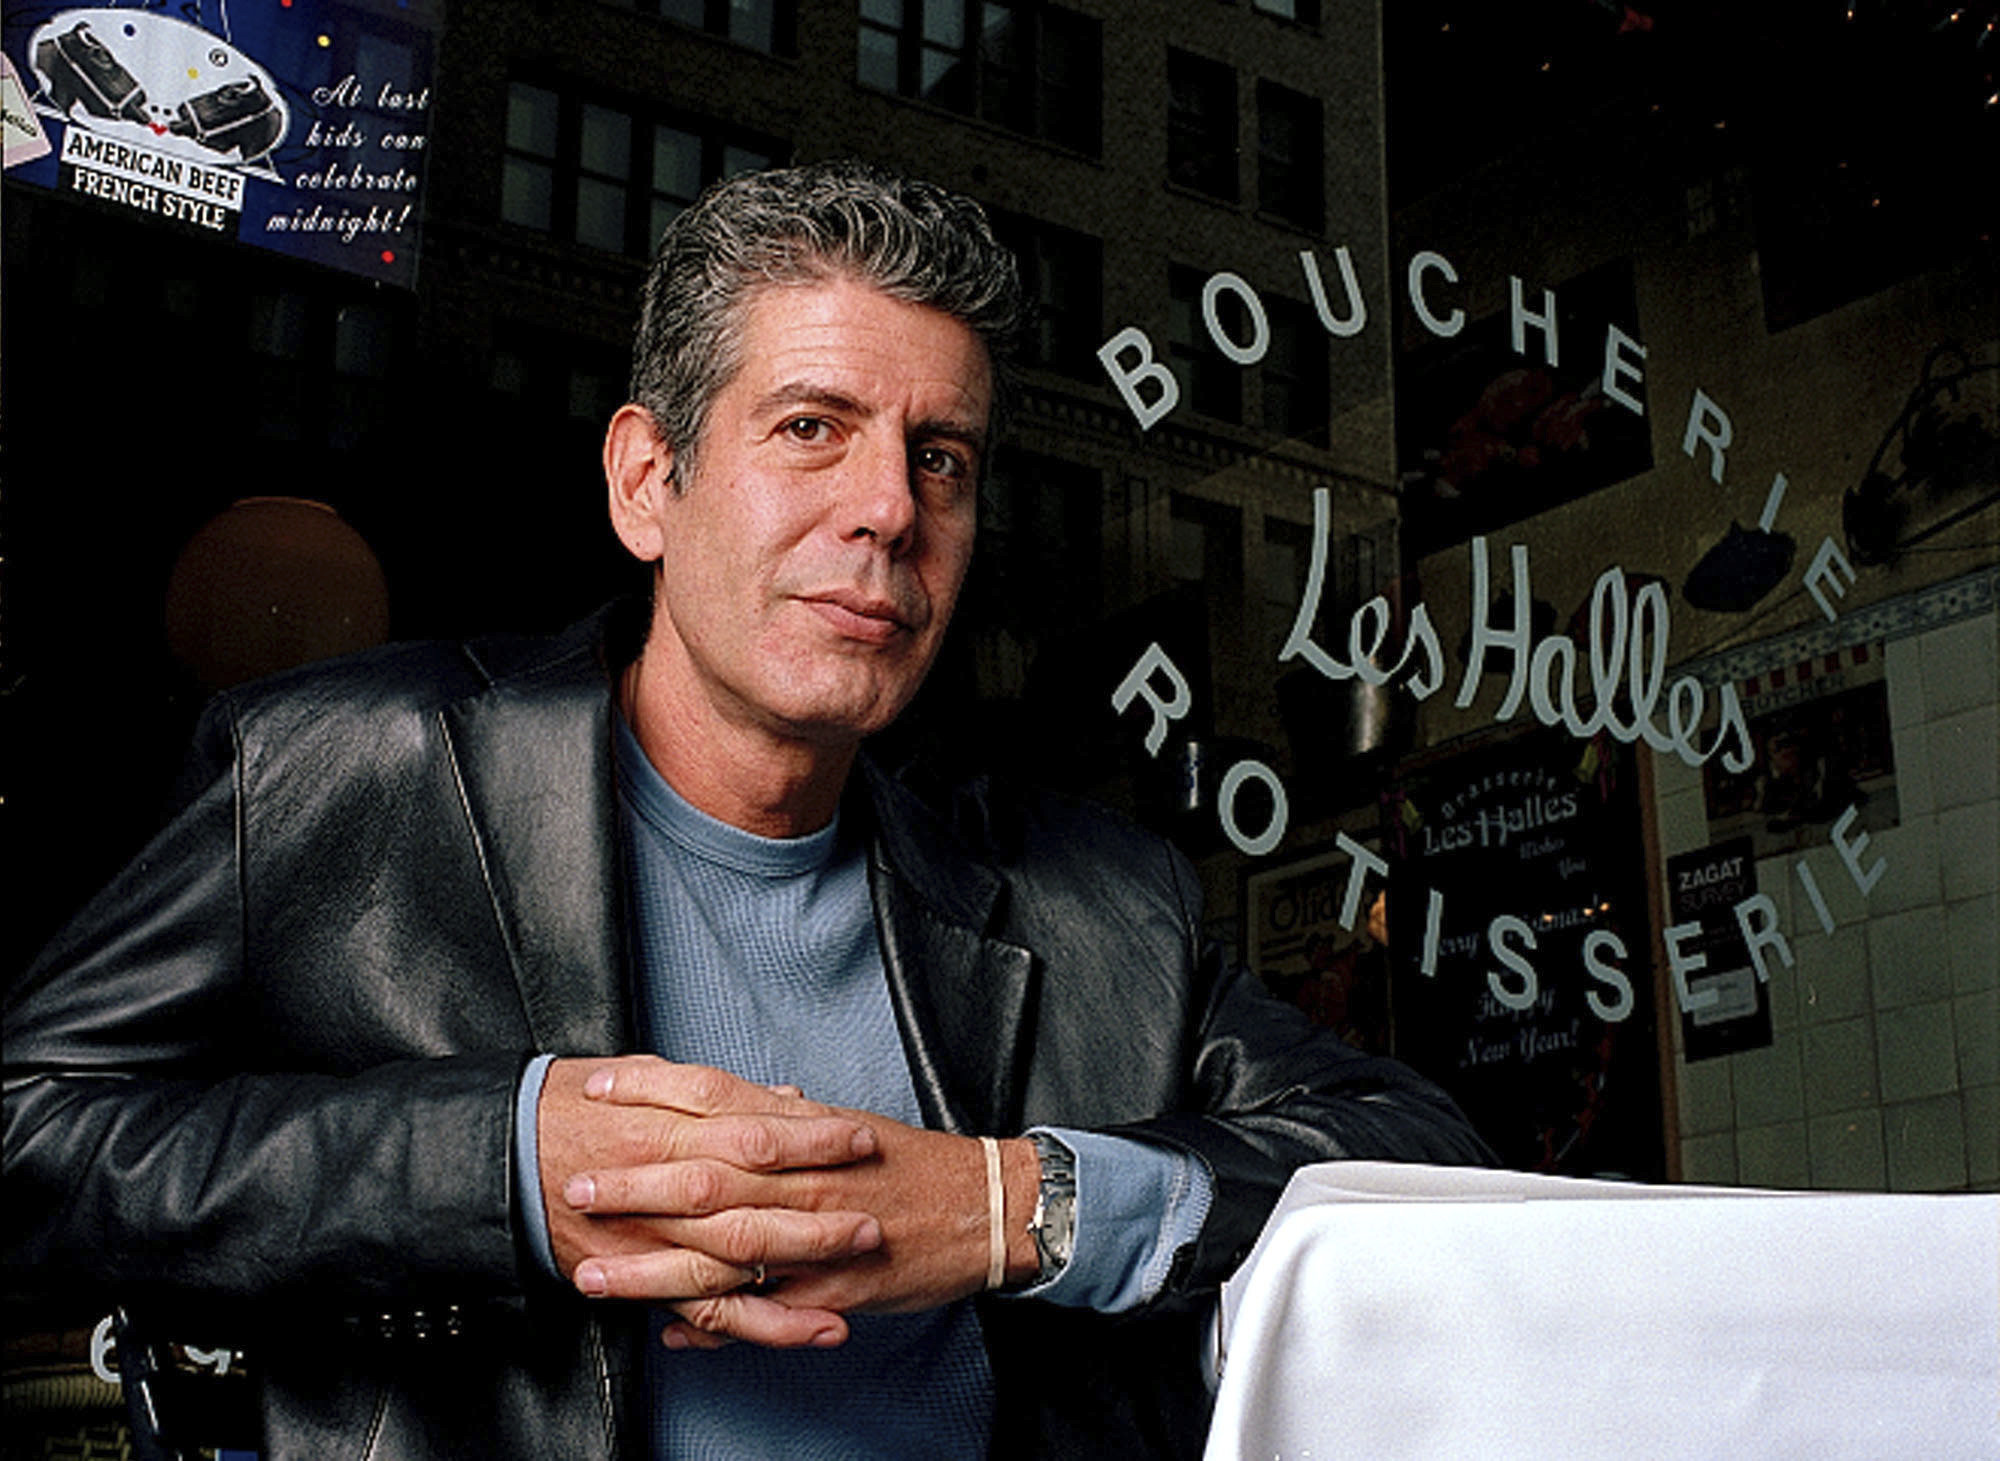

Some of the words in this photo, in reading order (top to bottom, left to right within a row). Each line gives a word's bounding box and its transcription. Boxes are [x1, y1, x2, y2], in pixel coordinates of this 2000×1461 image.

[312, 75, 362, 107] At
[378, 82, 429, 110] last
[305, 121, 368, 147] kids
[380, 133, 428, 149] can
[68, 133, 182, 184] AMERICAN
[188, 166, 241, 200] BEEF
[296, 163, 417, 189] celebrate
[73, 169, 158, 213] FRENCH
[163, 193, 226, 231] STYLE
[266, 205, 412, 243] midnight!
[1096, 246, 1857, 622] BOUCHERIE
[1279, 487, 1444, 702] Les
[1455, 536, 1755, 774] Halles
[1111, 641, 1889, 1023] ROTISSERIE
[1423, 823, 1474, 856] Les
[1475, 793, 1579, 848] Halles
[1678, 856, 1745, 892] ZAGAT
